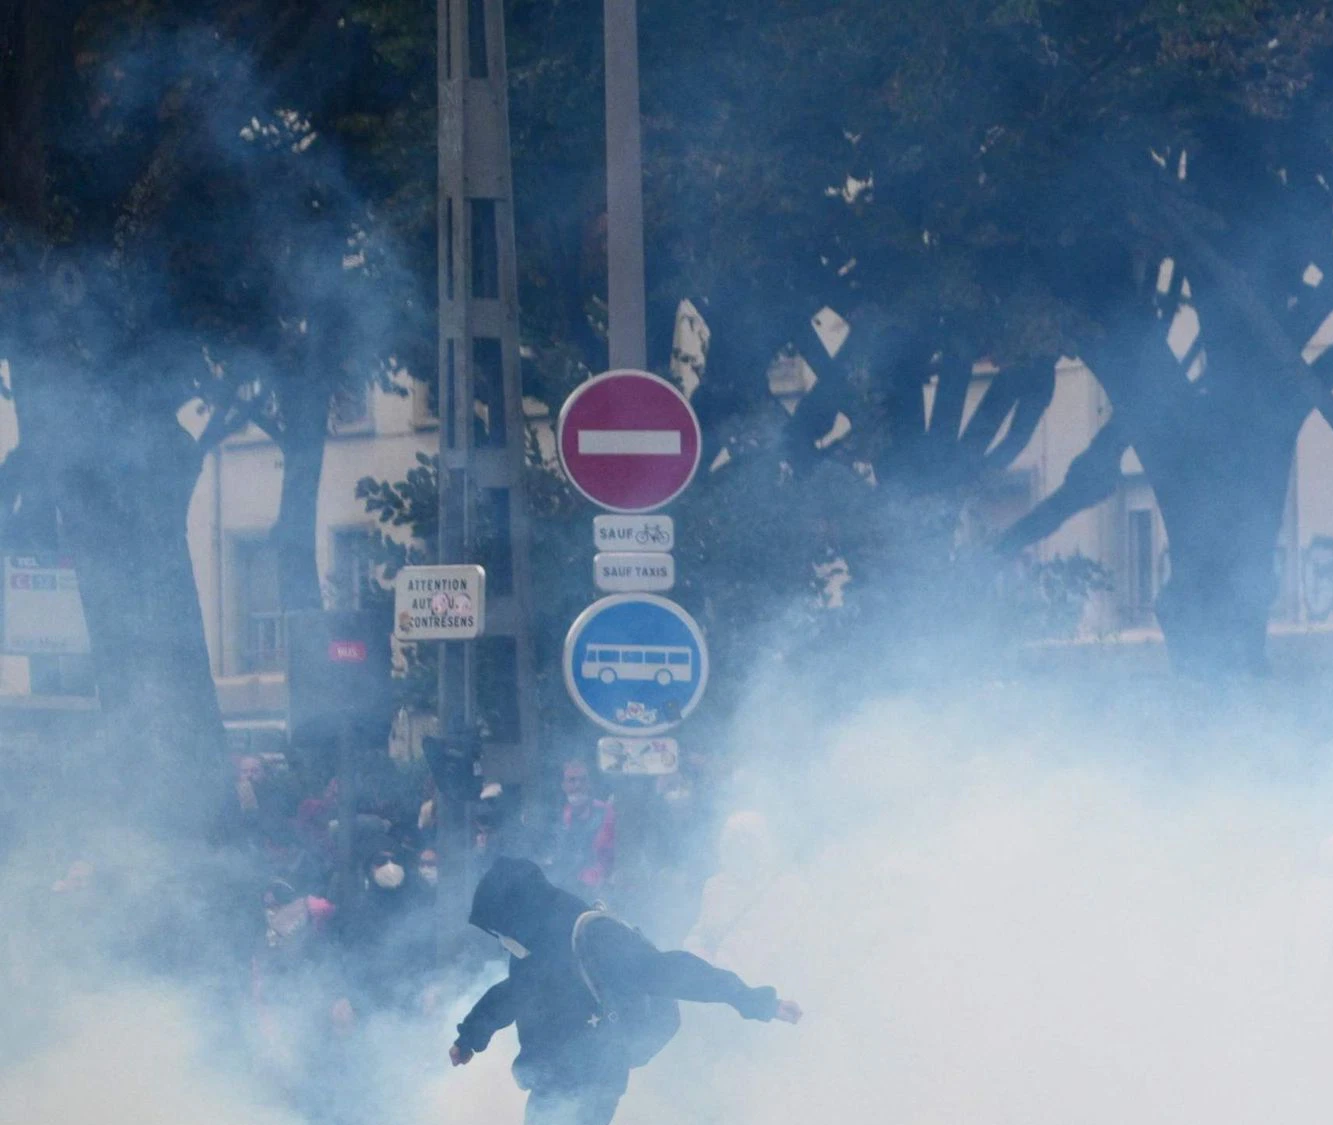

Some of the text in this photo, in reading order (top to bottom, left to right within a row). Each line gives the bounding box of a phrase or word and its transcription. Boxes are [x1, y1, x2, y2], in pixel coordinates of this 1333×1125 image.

[600, 527, 633, 540] SAUF
[603, 566, 667, 577] SAUF TAXIS
[408, 579, 467, 592] ATTENTION
